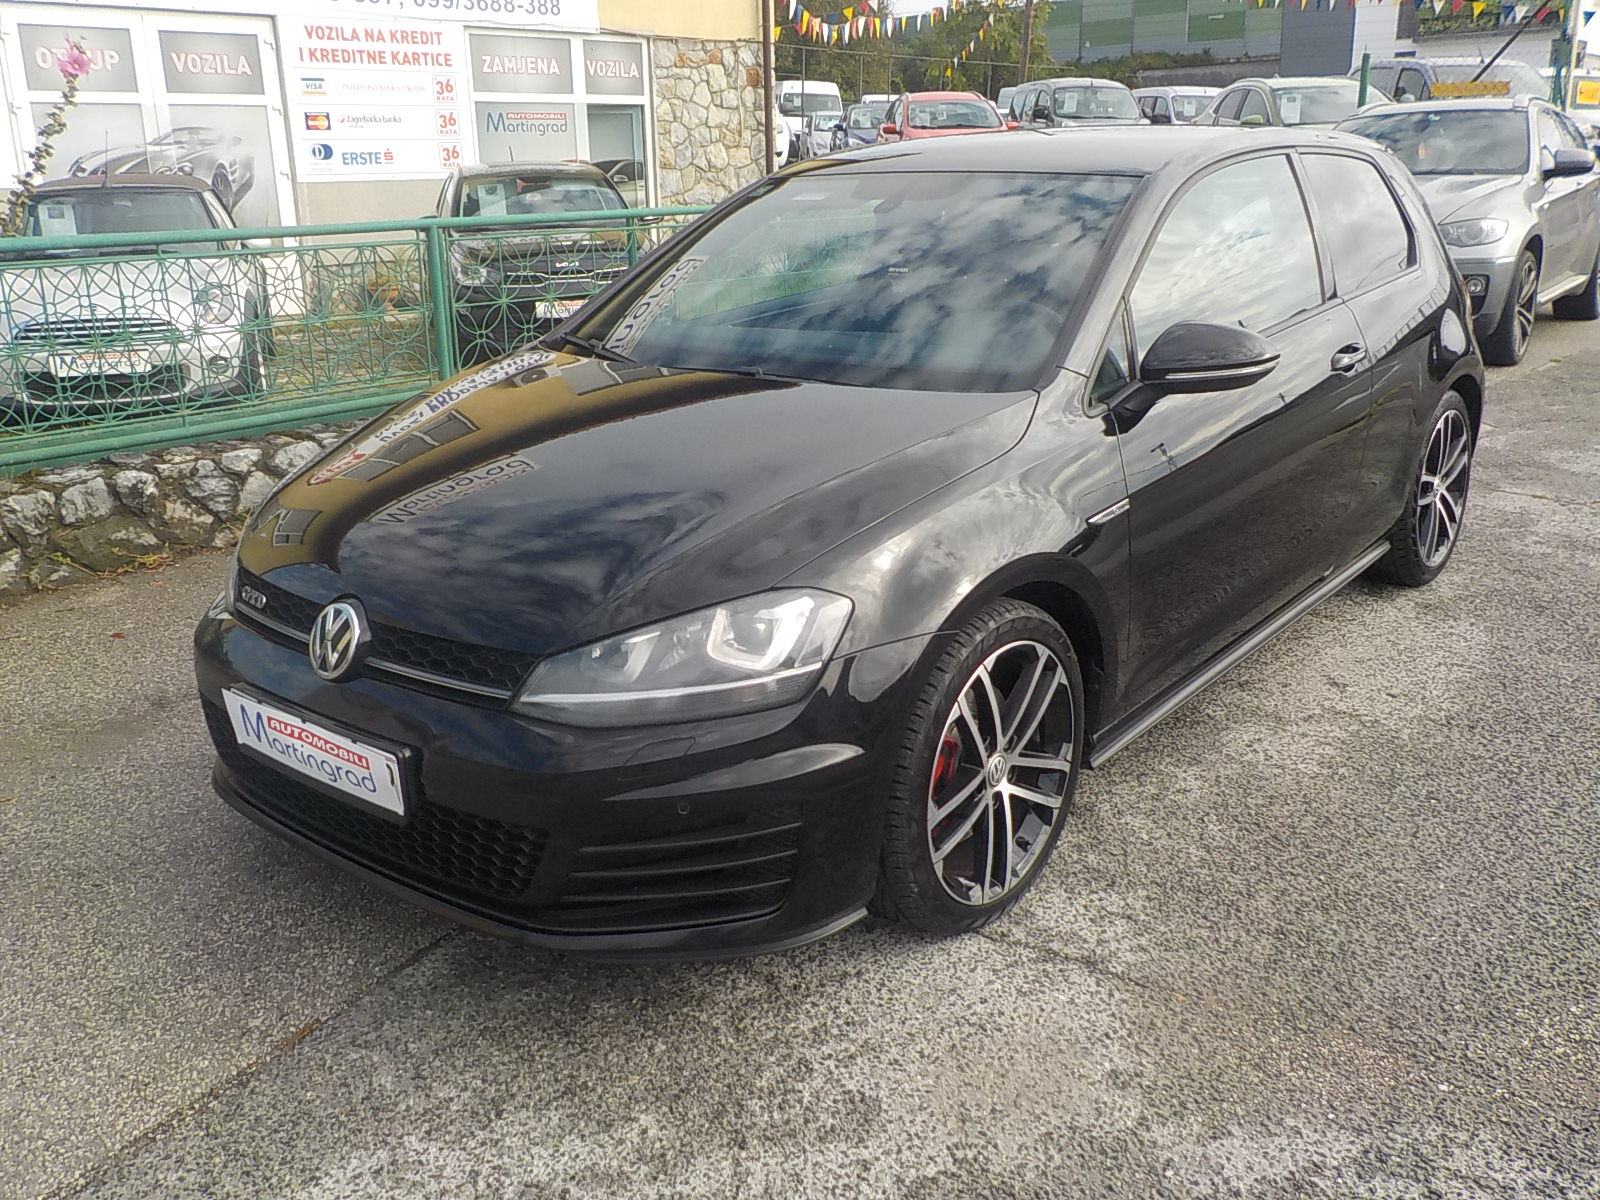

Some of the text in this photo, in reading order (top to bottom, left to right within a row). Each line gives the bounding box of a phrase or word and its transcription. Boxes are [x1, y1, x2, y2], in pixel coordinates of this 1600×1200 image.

[304, 25, 442, 46] VOZILA NA KREDIT
[35, 46, 120, 72] OTUP
[170, 51, 252, 76] VOZILA
[298, 46, 453, 67] I KREDITNE KARTICE
[481, 55, 560, 75] ZAMJENA
[586, 59, 639, 78] VOZILA
[436, 78, 453, 95] 36
[439, 112, 456, 129] 36
[486, 112, 567, 136] Martingrad
[342, 151, 382, 165] ERSTE
[442, 145, 460, 162] 36
[240, 703, 377, 793] Martingrad
[270, 719, 368, 768] AUTOMOBILI
